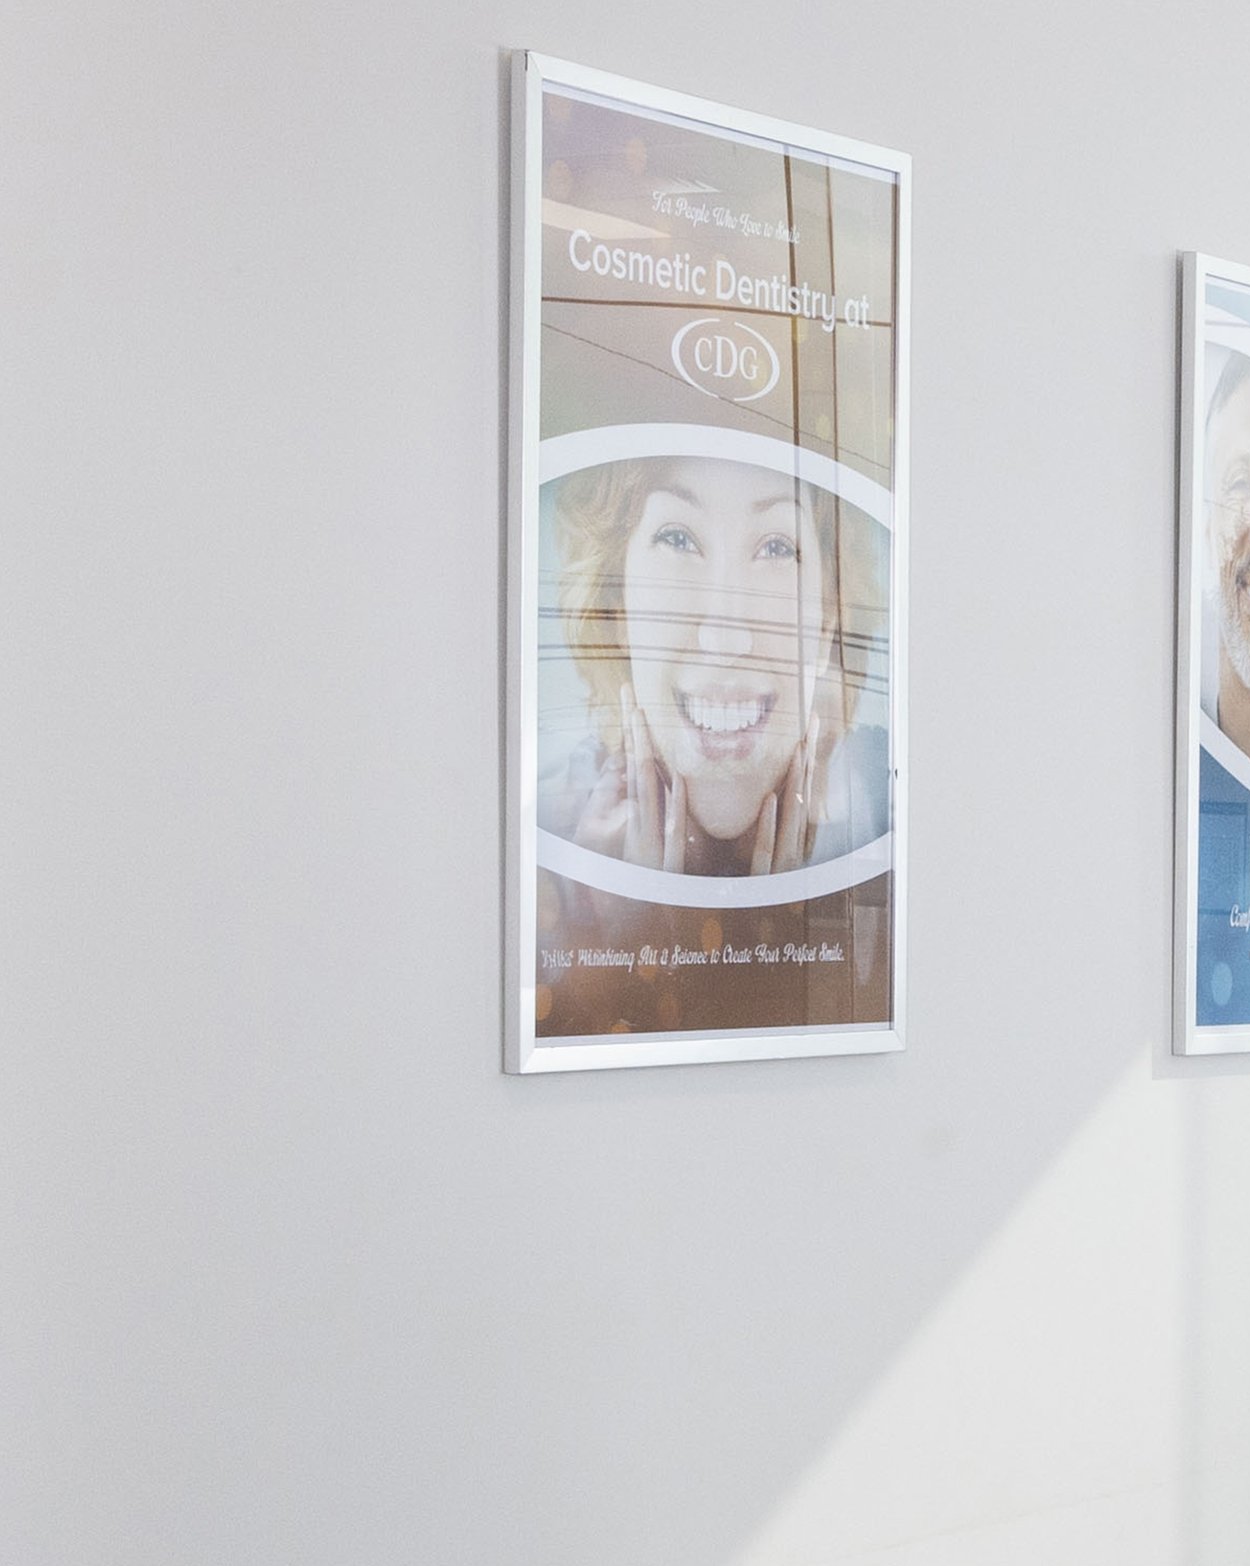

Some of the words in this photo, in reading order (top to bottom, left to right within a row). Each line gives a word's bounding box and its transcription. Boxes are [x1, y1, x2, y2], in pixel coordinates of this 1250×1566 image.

[651, 190, 671, 215] For
[675, 197, 710, 227] People
[712, 207, 738, 230] Who
[568, 228, 707, 297] Cosmetic
[715, 259, 835, 333] Dentistry
[844, 294, 870, 331] at
[693, 334, 760, 381] CDG
[671, 944, 709, 966] Science
[710, 948, 721, 964] to
[723, 944, 753, 964] Create
[755, 943, 780, 965] Your
[782, 942, 816, 966] Perfect
